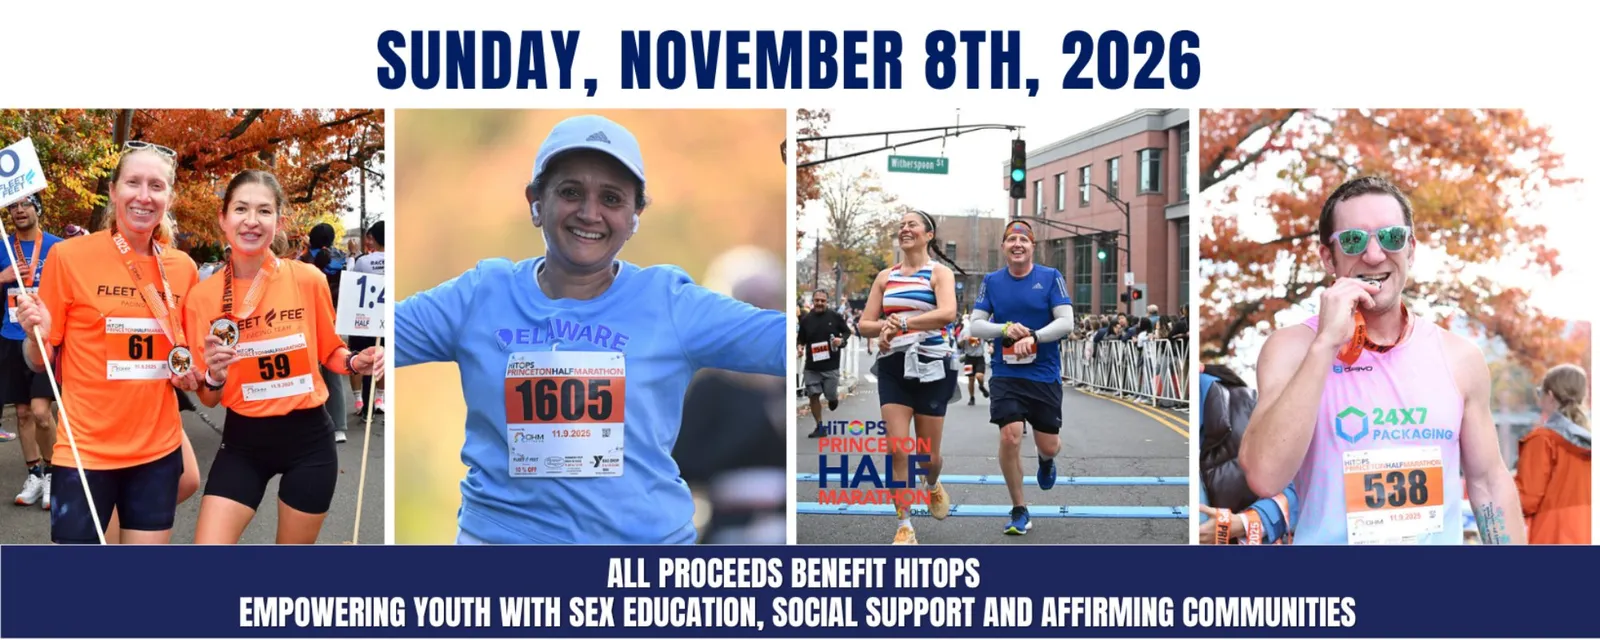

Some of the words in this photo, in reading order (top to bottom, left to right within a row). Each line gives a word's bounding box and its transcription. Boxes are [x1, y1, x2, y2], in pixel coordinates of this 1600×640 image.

[891, 158, 935, 171] Witherspoon
[0, 174, 25, 190] FLEET
[3, 182, 25, 198] FEET
[113, 234, 131, 254] 2025
[97, 285, 137, 297] FLEET
[238, 316, 261, 331] EET
[495, 318, 630, 352] DELAWARE
[128, 334, 153, 360] 61
[258, 353, 291, 380] 59
[515, 378, 613, 421] 1605
[1372, 407, 1428, 425] 24X7
[552, 429, 591, 438] 11.9.2025
[1372, 428, 1454, 441] PACKAGING
[1363, 469, 1429, 509] 538
[1389, 512, 1422, 521] 11.9.2025
